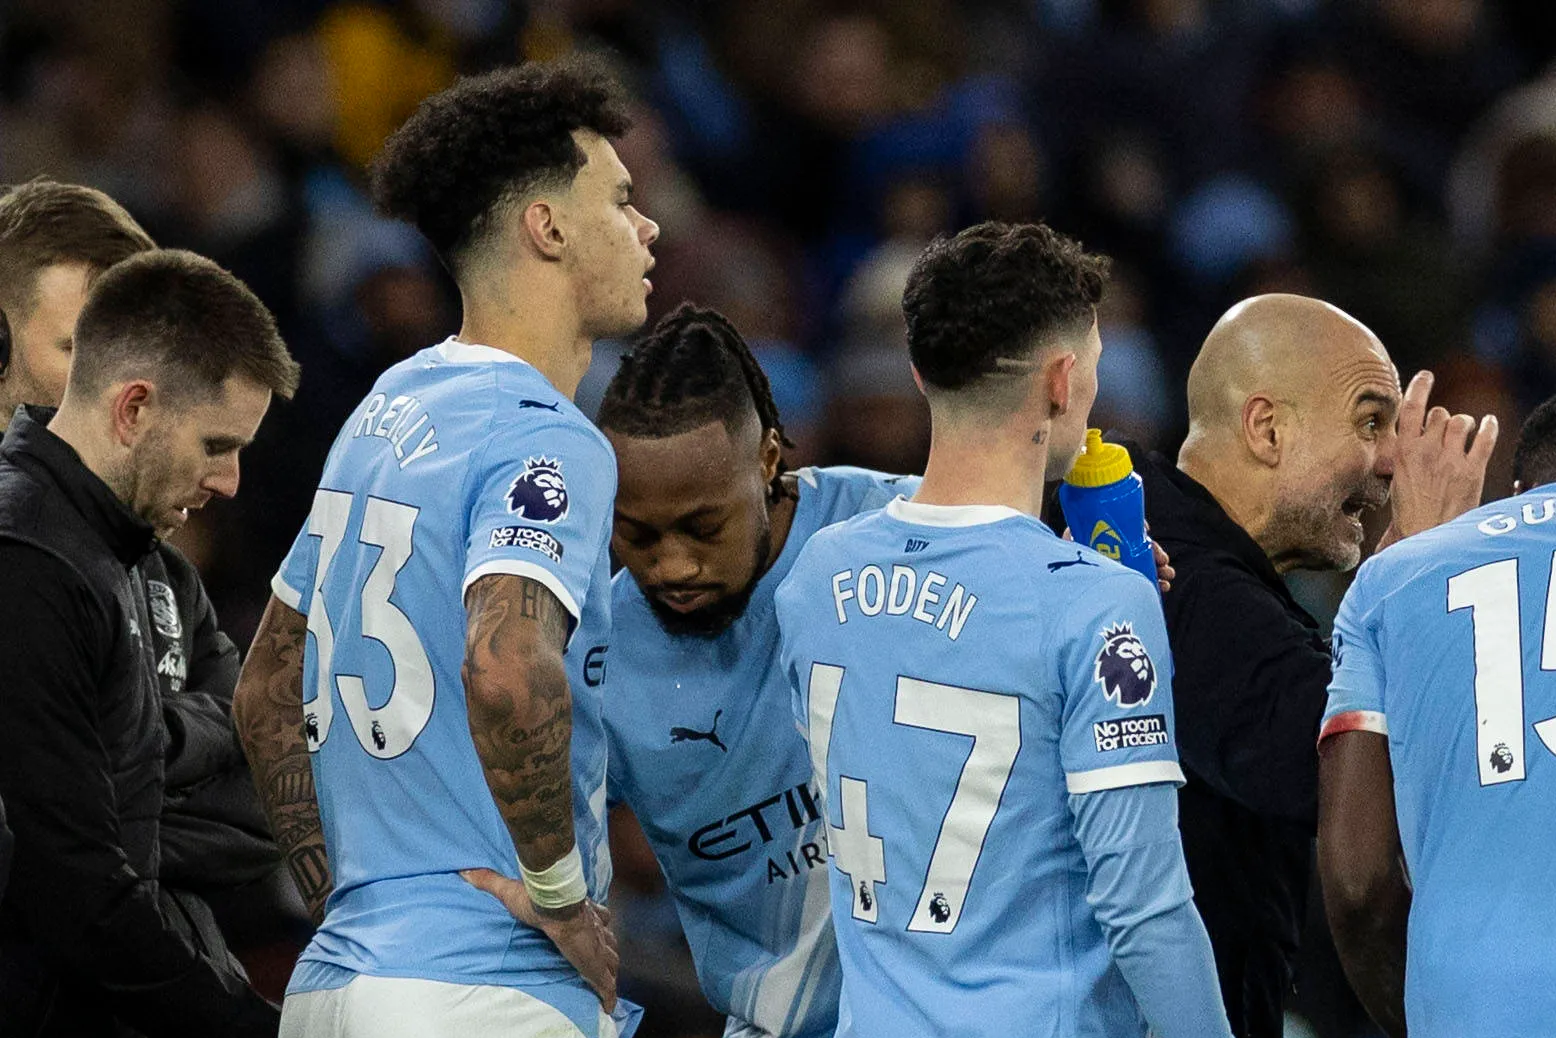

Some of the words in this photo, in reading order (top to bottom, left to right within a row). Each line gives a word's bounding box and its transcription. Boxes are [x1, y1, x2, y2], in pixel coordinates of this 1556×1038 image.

[489, 537, 513, 550] for
[513, 538, 561, 564] racism
[491, 527, 512, 539] No
[516, 527, 558, 553] room
[832, 564, 979, 641] FODEN
[302, 487, 437, 761] 33
[1094, 722, 1119, 740] No
[1121, 718, 1160, 734] room
[1096, 736, 1120, 752] for
[1122, 731, 1169, 747] racism
[807, 661, 1022, 935] 47
